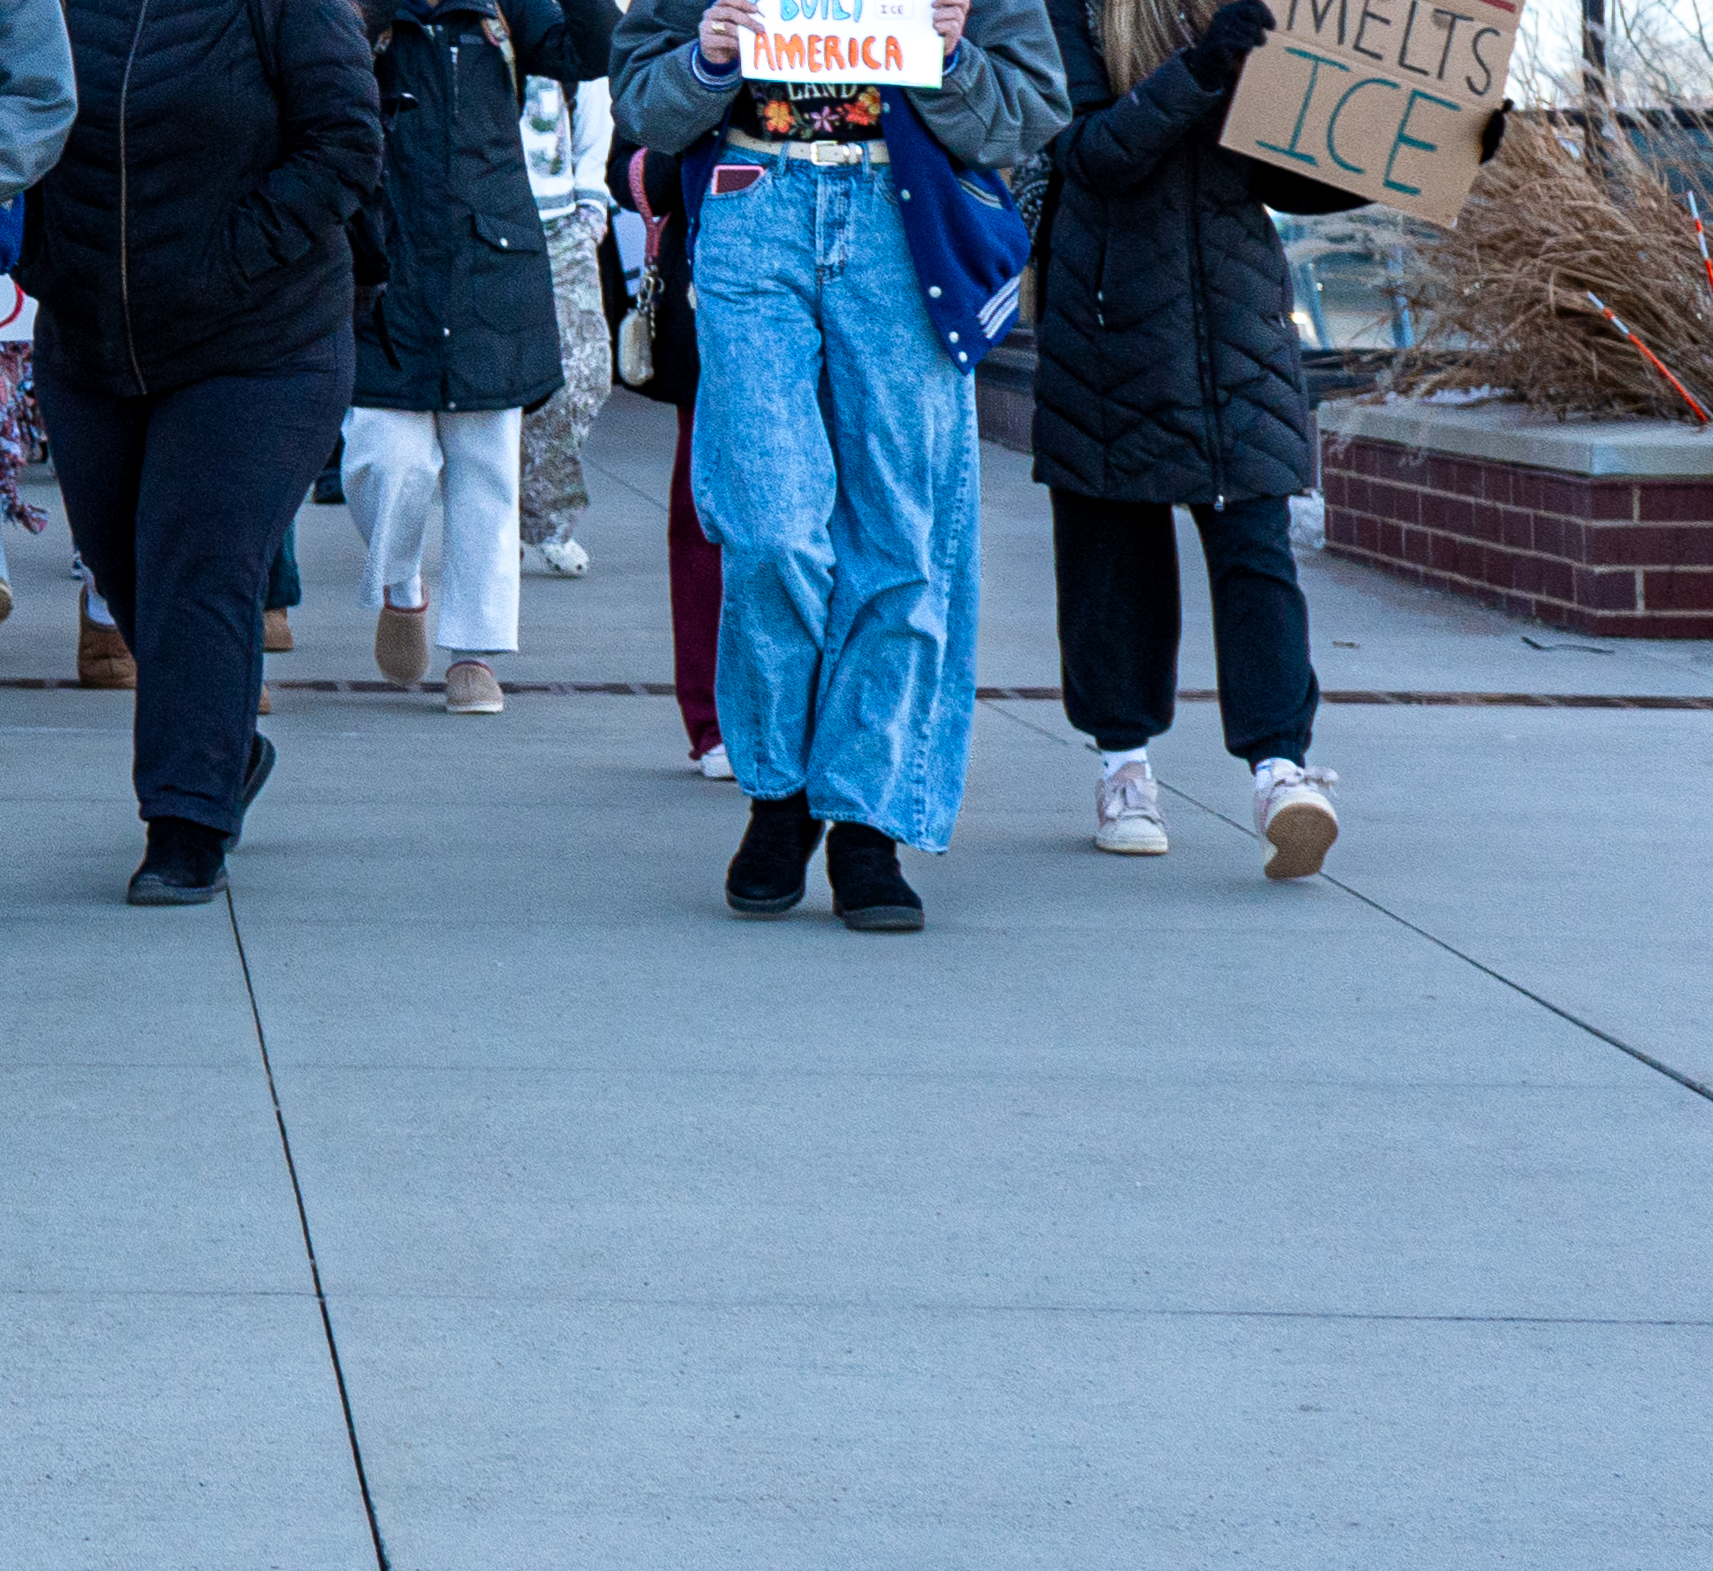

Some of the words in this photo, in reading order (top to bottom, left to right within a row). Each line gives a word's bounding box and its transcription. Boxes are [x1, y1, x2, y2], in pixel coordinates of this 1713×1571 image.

[880, 4, 904, 15] ICE
[753, 32, 903, 73] AMERICA
[1255, 46, 1462, 196] ICE
